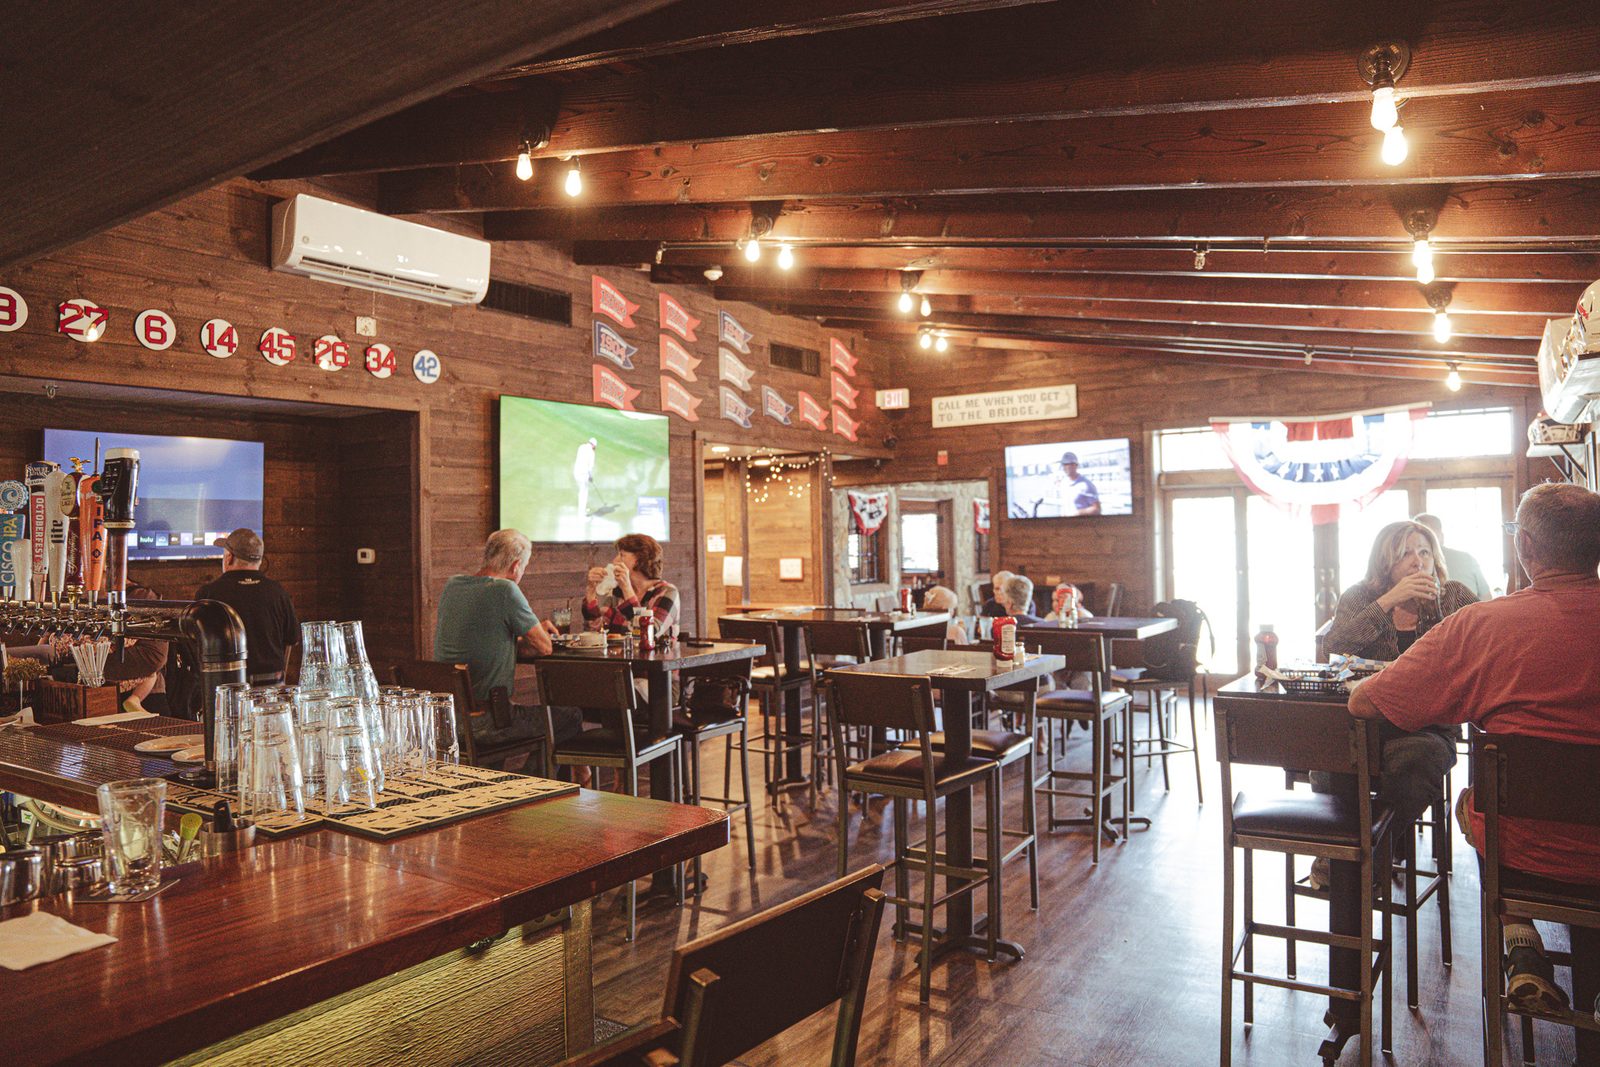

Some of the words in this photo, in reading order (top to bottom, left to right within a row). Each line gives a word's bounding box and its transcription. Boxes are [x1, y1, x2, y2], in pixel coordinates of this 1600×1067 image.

[59, 303, 109, 337] 27
[144, 315, 167, 345] 6
[205, 322, 237, 354] 14
[259, 332, 296, 361] 45
[314, 339, 350, 368] 26
[366, 347, 397, 375] 34
[415, 355, 438, 378] 42
[937, 401, 960, 411] CALL
[965, 399, 979, 409] ME
[983, 396, 1014, 407] WHEN
[1017, 393, 1037, 404] YOU
[1040, 391, 1060, 402] GET
[938, 413, 953, 423] TO
[960, 410, 982, 421] THE
[3, 517, 17, 537] IPA
[35, 497, 45, 559] OCTOBERFEST
[92, 506, 103, 541] IPA
[1, 541, 14, 583] CISCO
